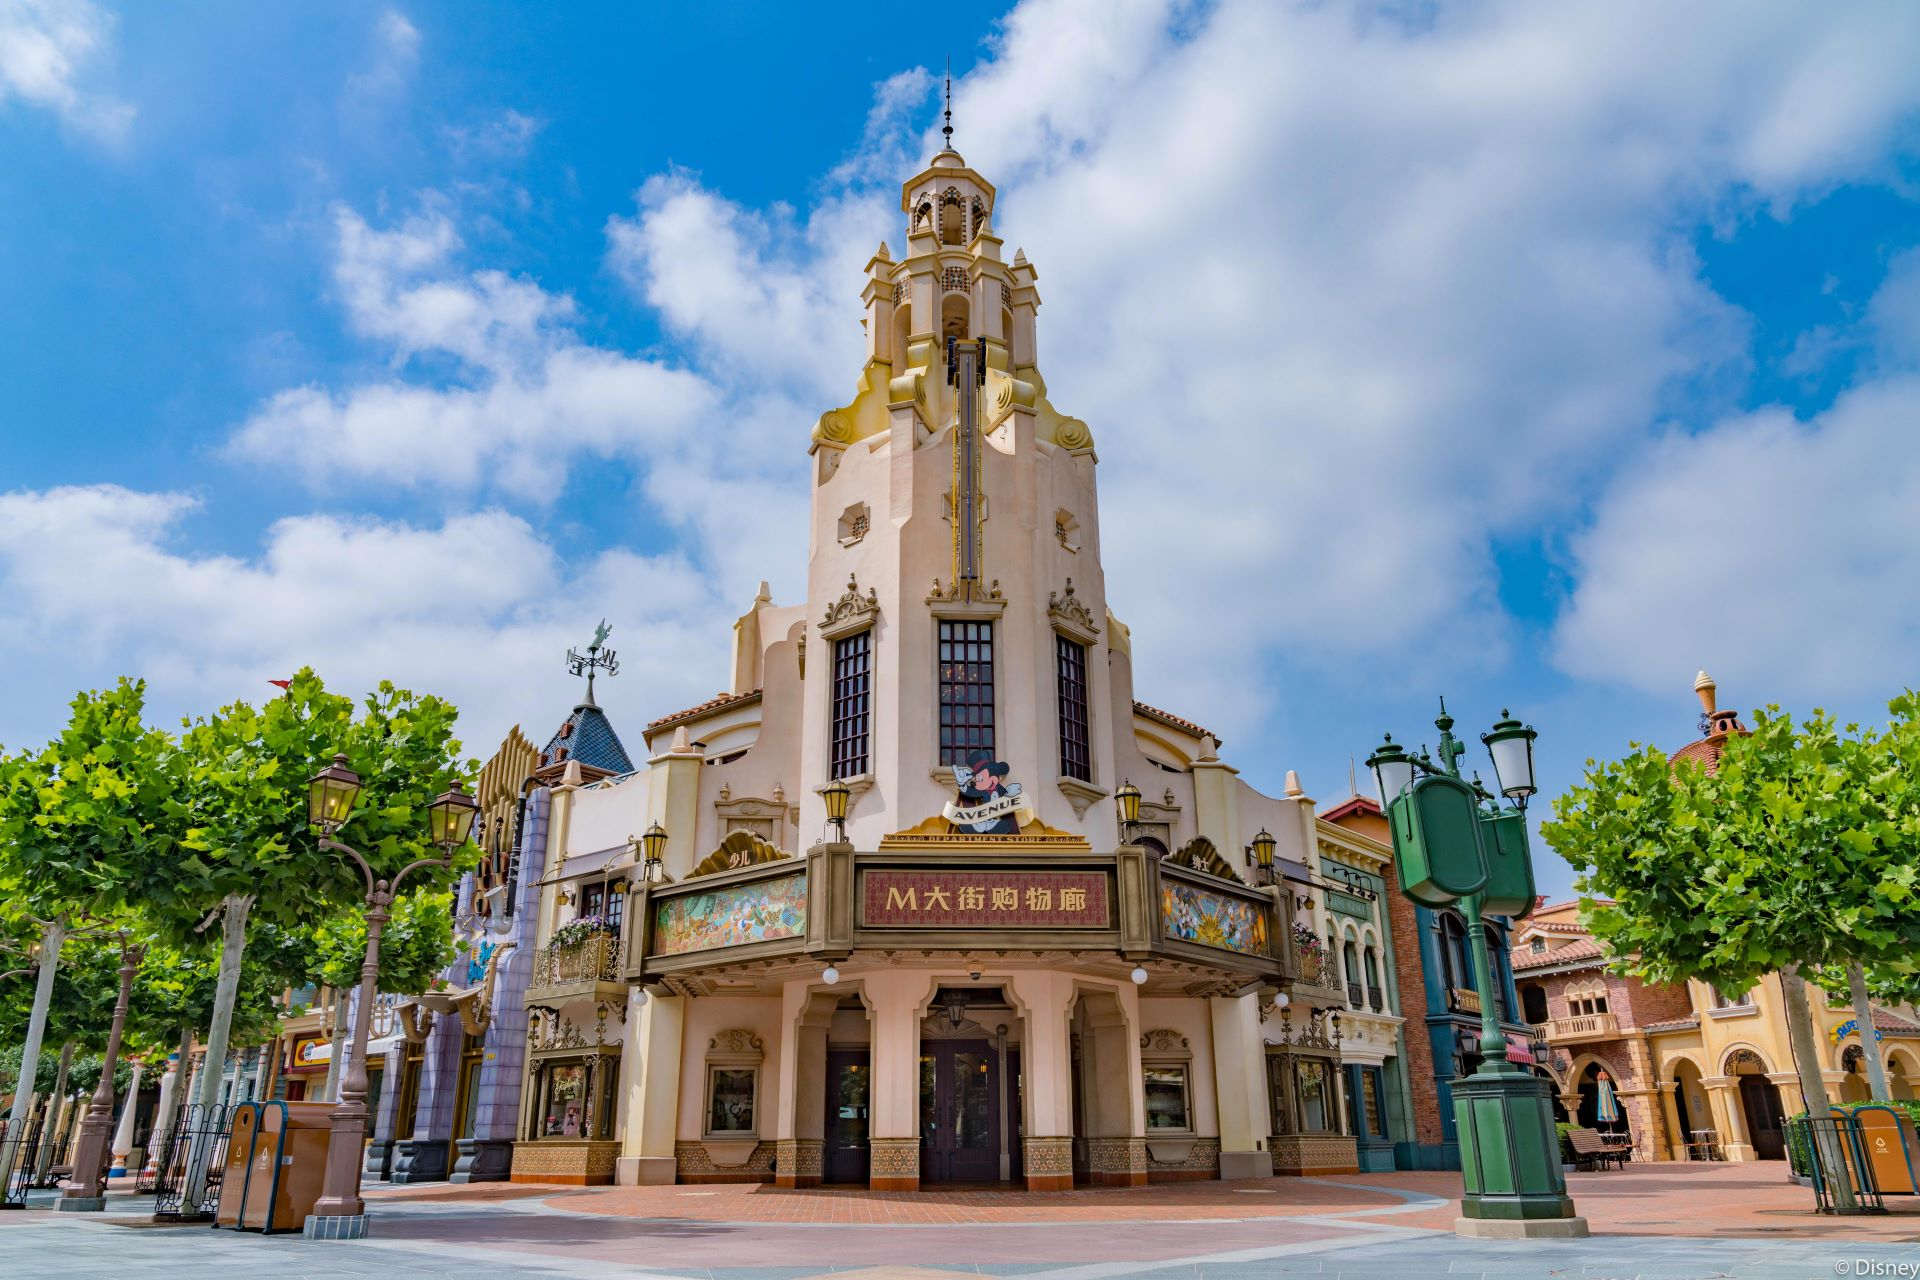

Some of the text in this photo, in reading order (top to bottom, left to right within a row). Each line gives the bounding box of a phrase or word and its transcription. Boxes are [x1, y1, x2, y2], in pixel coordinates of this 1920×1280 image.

[602, 646, 616, 665] W
[954, 796, 1021, 820] AVENUE
[1006, 835, 1043, 843] STORE
[728, 849, 751, 869] 少儿
[885, 886, 1087, 911] M大街购物廊
